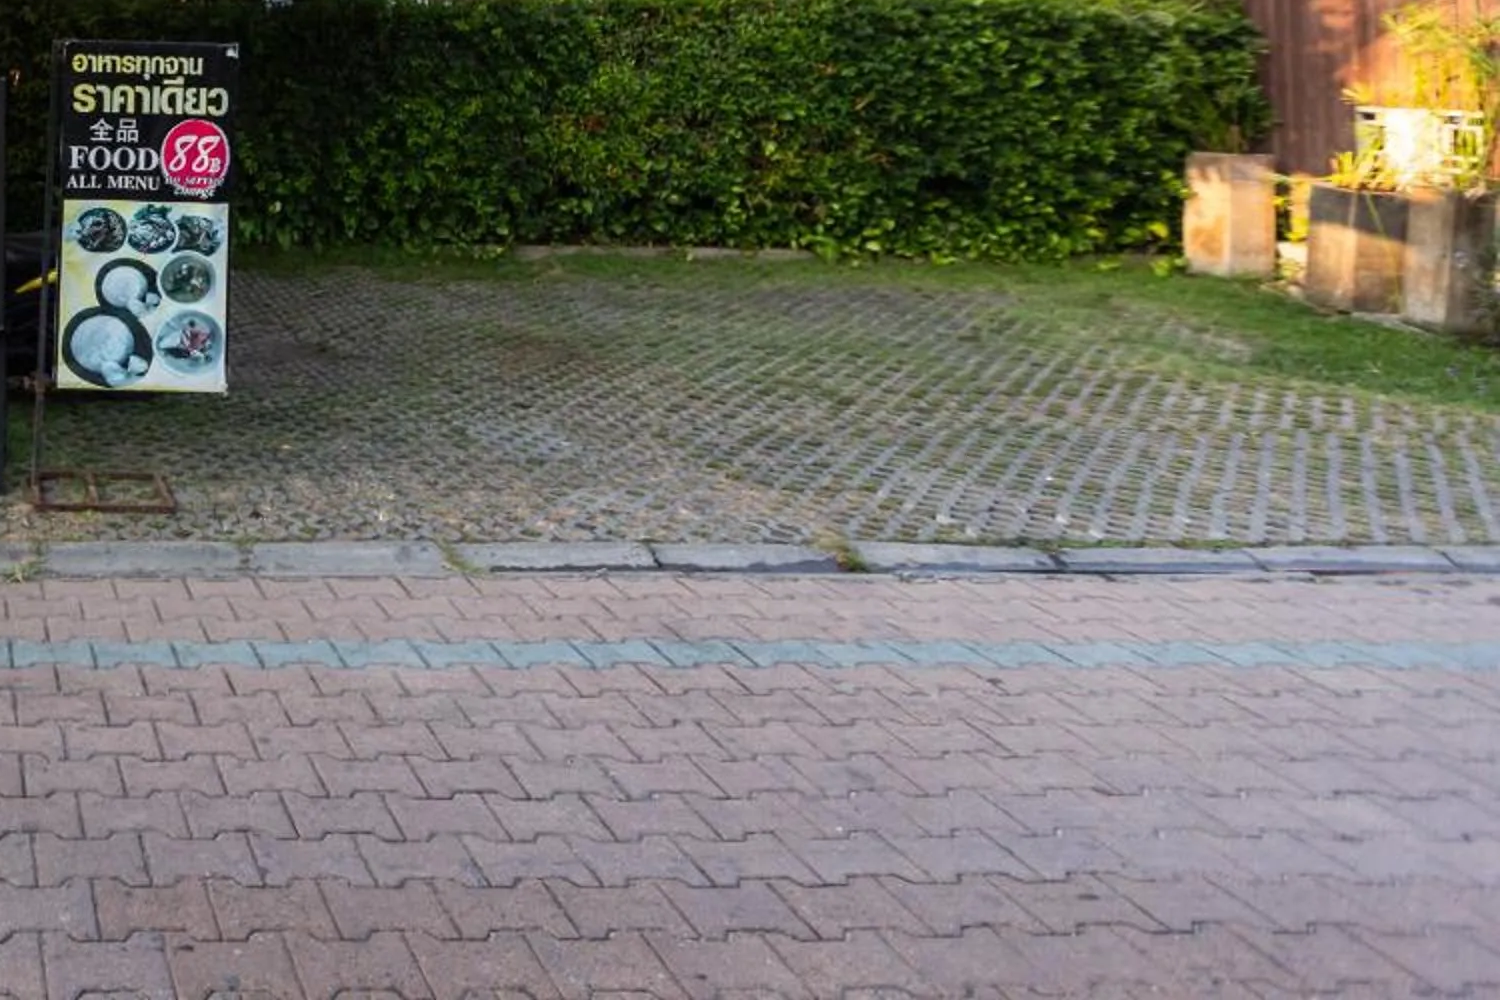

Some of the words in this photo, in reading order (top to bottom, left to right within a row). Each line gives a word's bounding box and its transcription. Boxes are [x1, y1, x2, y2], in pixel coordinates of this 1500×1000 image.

[72, 53, 204, 81] อาหารทุกจาน
[72, 76, 229, 117] ราคาเดียว
[89, 117, 139, 143] 全品
[68, 145, 159, 171] FOOD
[66, 174, 101, 189] ALL
[107, 175, 160, 191] MENU
